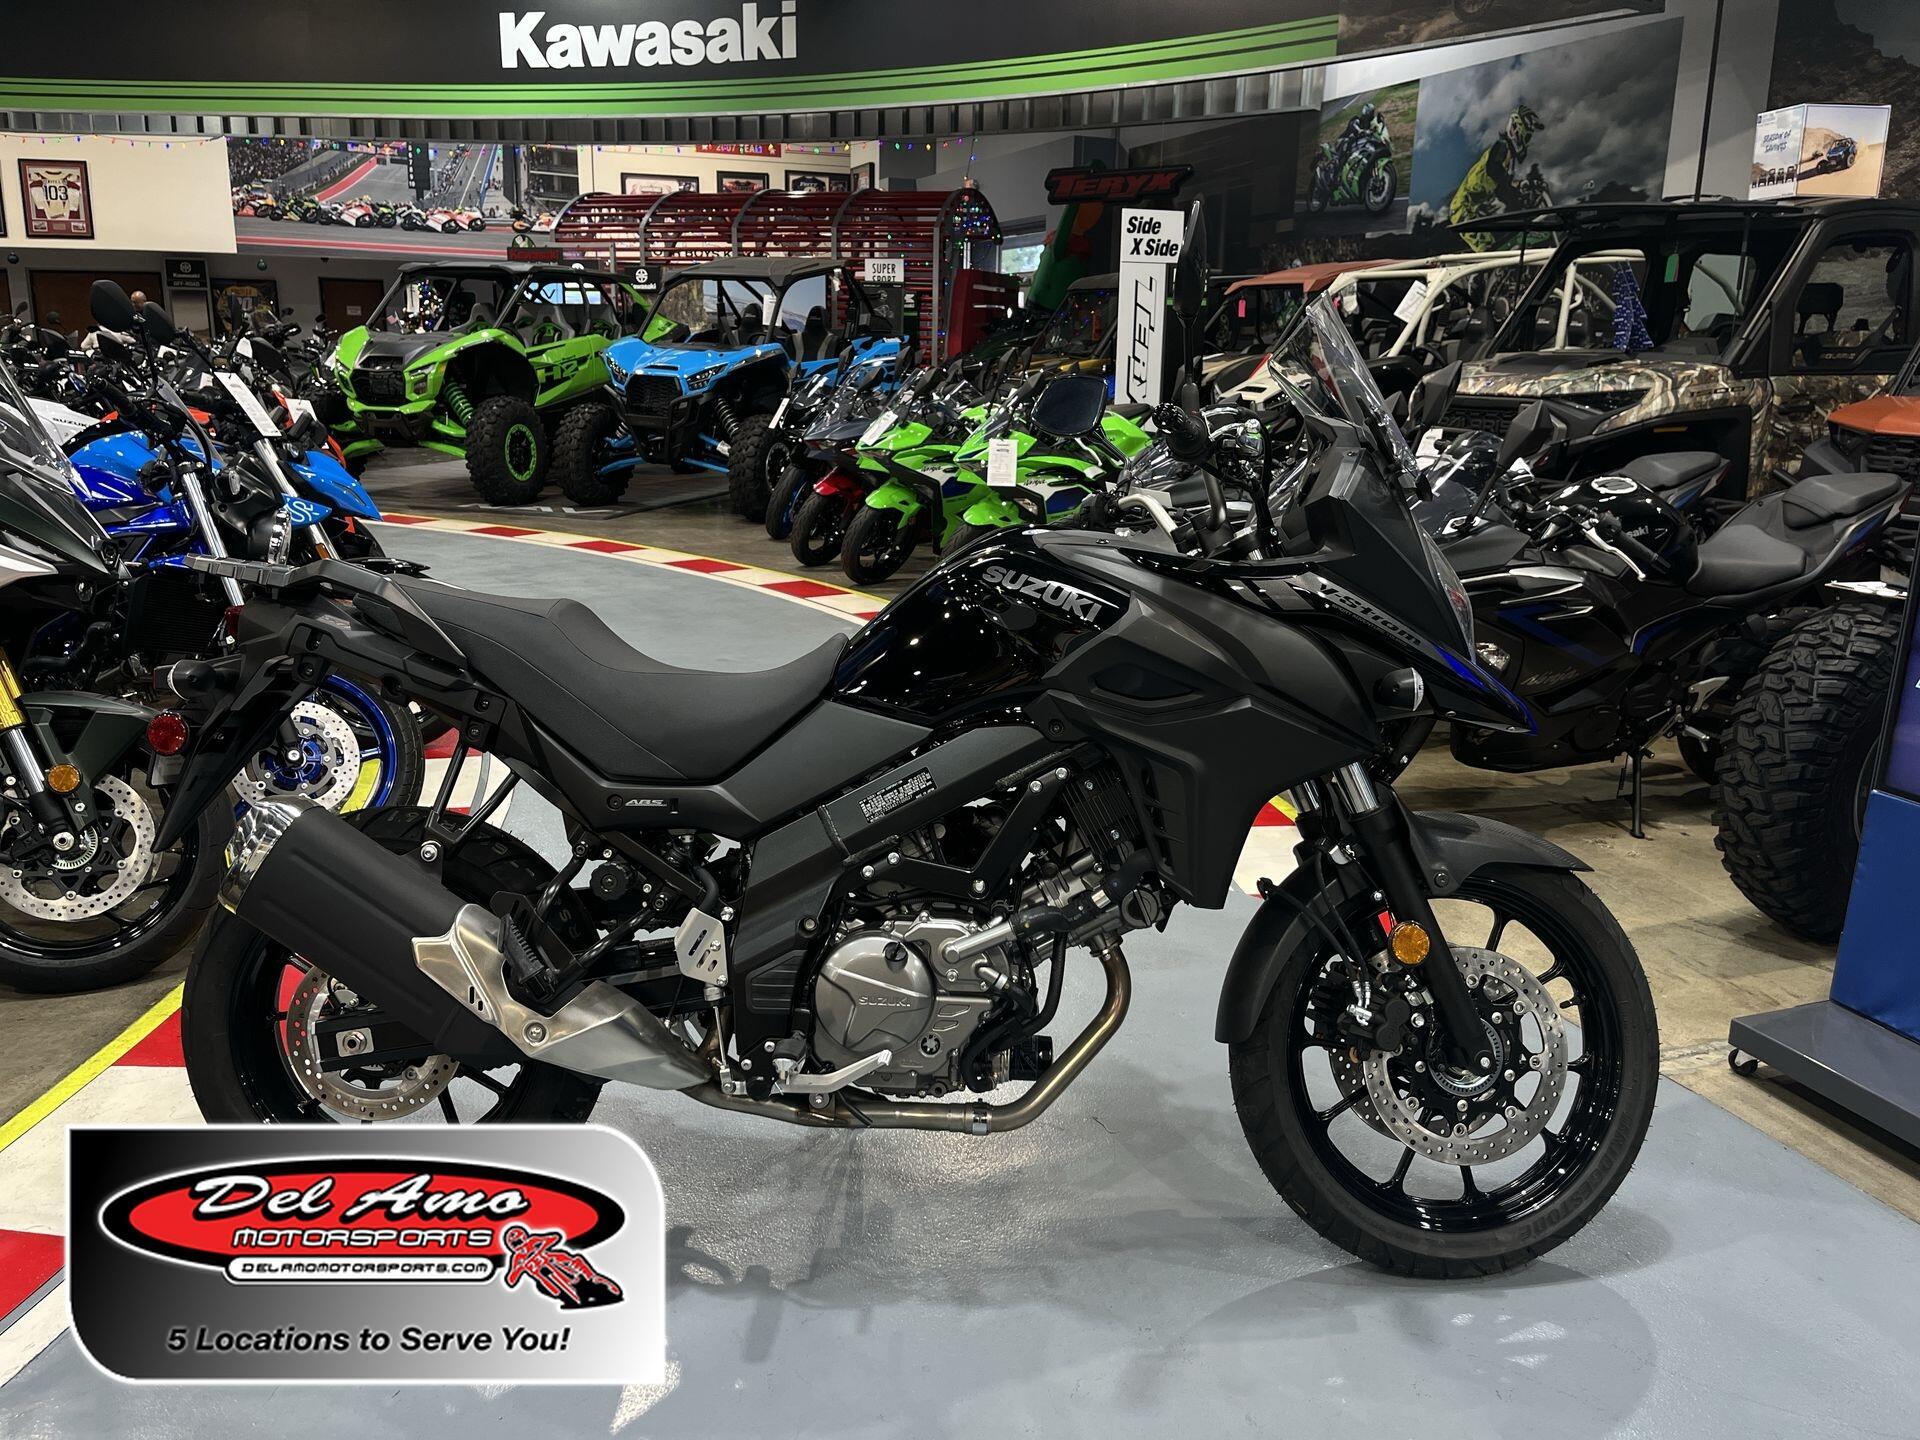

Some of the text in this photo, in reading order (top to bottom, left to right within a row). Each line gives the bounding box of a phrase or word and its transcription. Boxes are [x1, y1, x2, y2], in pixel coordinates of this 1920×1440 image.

[499, 1, 797, 69] Kawasaki
[44, 185, 69, 201] 103
[1051, 172, 1178, 198] TERYX
[1126, 216, 1162, 235] Side
[1130, 238, 1179, 257] X Side
[872, 263, 897, 274] SUPER
[631, 282, 657, 290] awasaki
[1126, 275, 1158, 404] TERY
[53, 417, 88, 428] SUZUKI
[1627, 525, 1650, 538] saki
[982, 565, 1103, 622] SUZUKI
[1320, 583, 1422, 646] V-Strom
[625, 799, 667, 807] ABS
[858, 995, 911, 1008] SUZUKI
